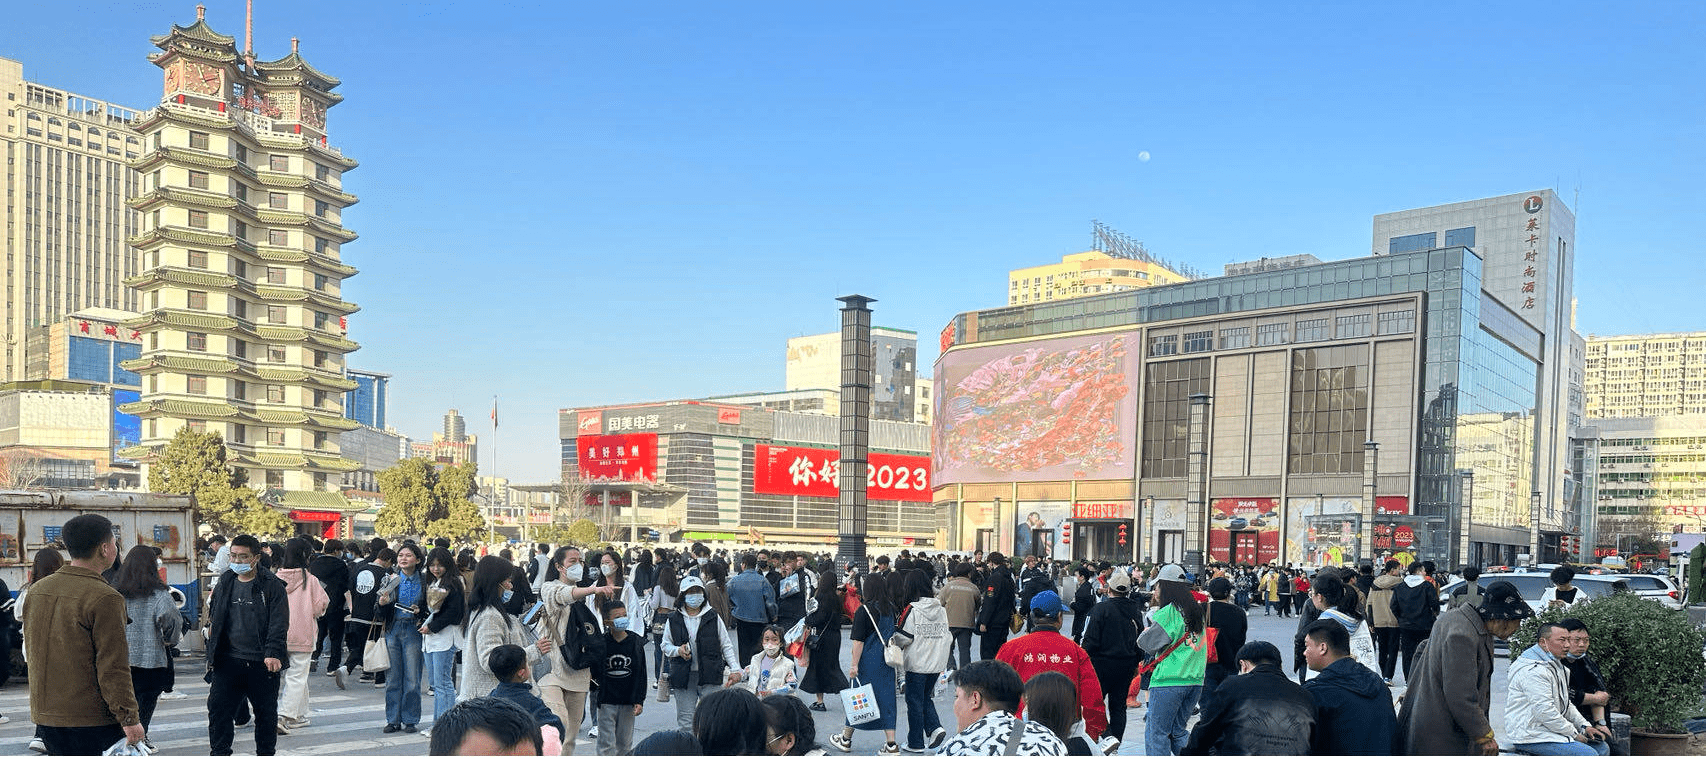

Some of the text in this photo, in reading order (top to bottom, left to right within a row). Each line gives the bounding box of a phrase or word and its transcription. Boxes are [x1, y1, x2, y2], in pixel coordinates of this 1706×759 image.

[1521, 217, 1540, 310] 莱卡时尚酒店
[608, 413, 659, 432] 国美电器
[867, 463, 927, 491] 2023
[1072, 503, 1118, 519] 亚细亚
[1395, 531, 1414, 539] 2023
[1023, 652, 1074, 664] 鸿润物业
